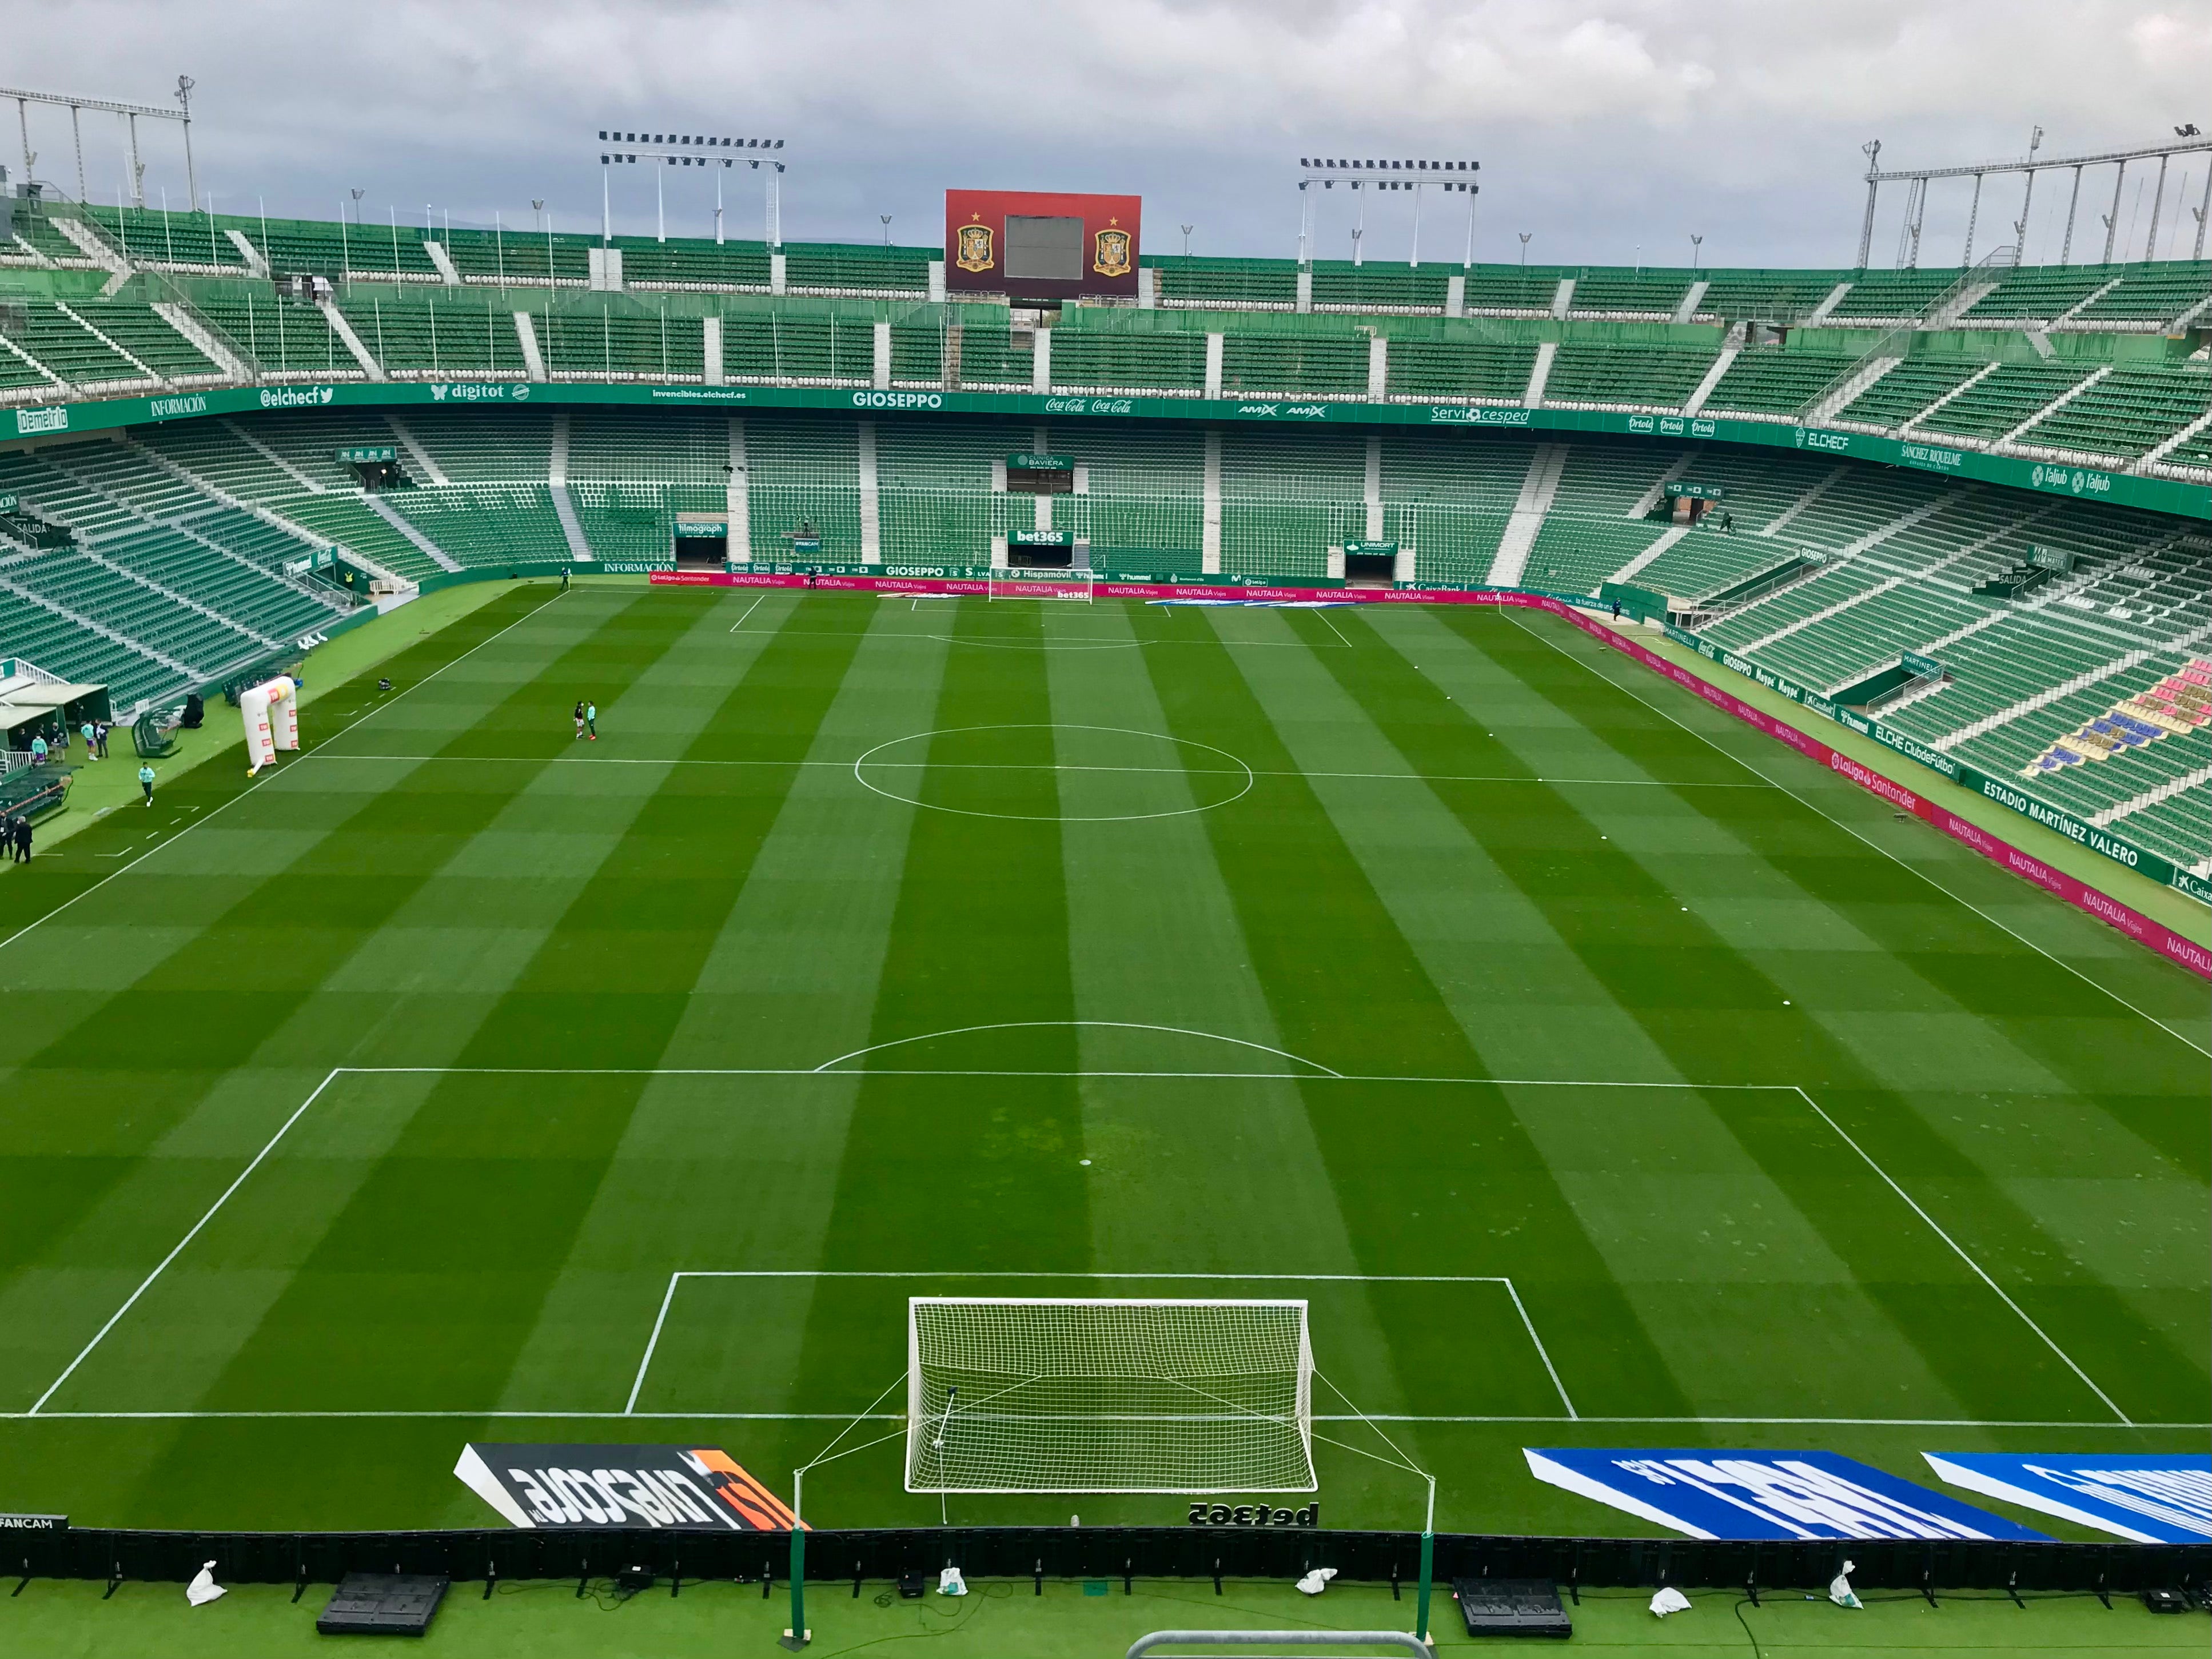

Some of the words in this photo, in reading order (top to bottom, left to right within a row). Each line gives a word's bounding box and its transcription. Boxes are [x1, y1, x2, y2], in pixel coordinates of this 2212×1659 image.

[260, 386, 318, 407] @elchecf
[452, 384, 504, 401] digitot
[652, 389, 746, 399] invencibles.elchecf.es
[852, 392, 942, 408] GIOSEPPO
[151, 393, 207, 416] INFORMACIÓN
[1808, 433, 1849, 450] ELCHECF
[17, 523, 47, 534] SALIDA
[1017, 531, 1063, 542] bet365
[1801, 547, 1827, 564] GIOSEPPO
[604, 562, 674, 572] INFORMACIÓN
[886, 567, 944, 577] GIOSEPPO
[1023, 570, 1071, 579] Hispamóvil
[733, 576, 771, 585] NAUTALIA
[875, 581, 913, 589] NAUTALIA
[946, 583, 983, 591] NAUTALIA
[1999, 574, 2027, 585] SALIDA
[1015, 585, 1053, 593] NAUTALIA
[1176, 588, 1213, 596] NAUTALIA
[1316, 591, 1353, 599] NAUTALIA
[1665, 625, 1695, 647] MARTINELLI
[1723, 653, 1752, 677] GIOSEPPO
[1756, 667, 1775, 687] Maype
[1703, 685, 1721, 701] NAUTALIA
[1778, 679, 1798, 699] Maype
[1737, 704, 1757, 722] NAUTALIA
[1846, 715, 1869, 734] hummel
[1775, 724, 1798, 744] NAUTALIA
[1875, 725, 1904, 750] ELCHE
[1840, 760, 1864, 781] LaLiga
[1871, 773, 1916, 810] Santander
[1949, 818, 1982, 846] NAUTALIA
[1983, 781, 2026, 812] ESTADIO
[2028, 802, 2086, 842] MARTÍNEZ
[2090, 831, 2138, 867] VALERO
[2009, 852, 2047, 884] NAUTALIA
[2047, 876, 2062, 890] Viajes
[2190, 880, 2212, 902] Caixa
[2083, 891, 2126, 926] NAUTALIA
[2127, 918, 2143, 934] Viajes
[2167, 937, 2212, 972] NAUTALI
